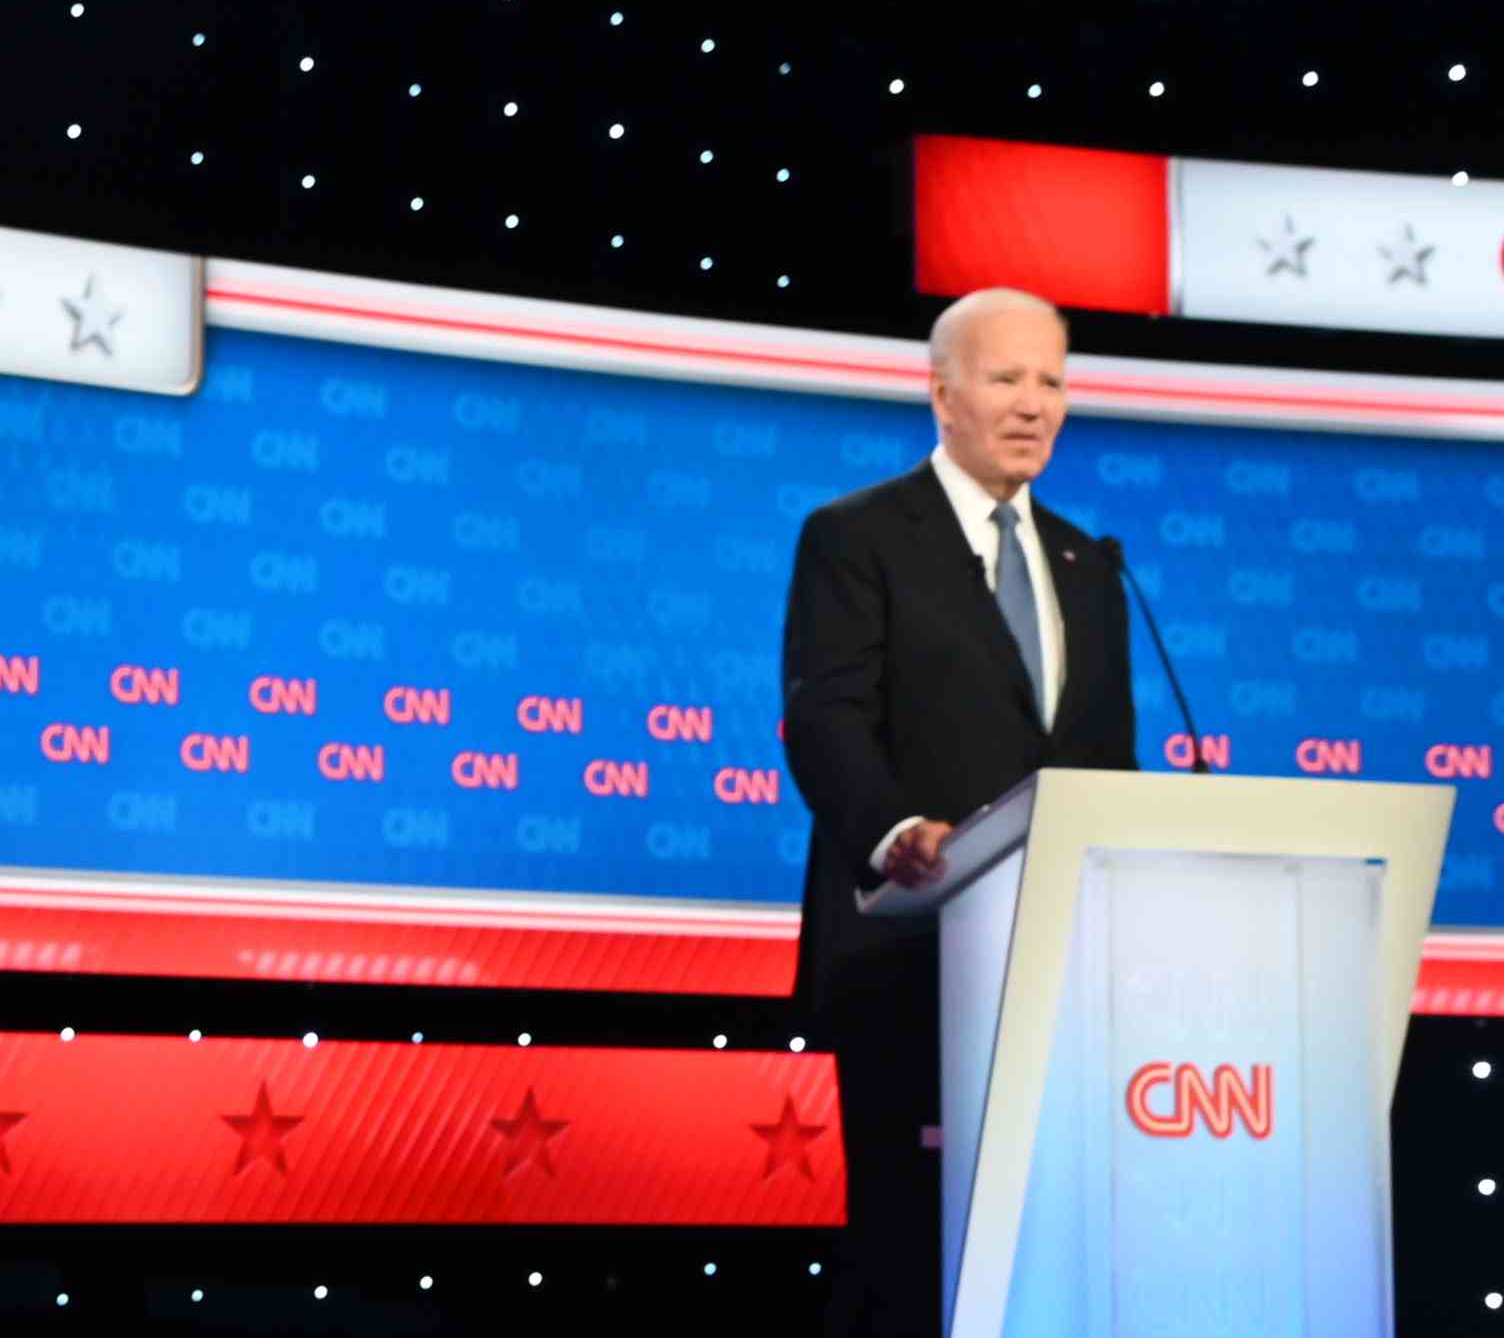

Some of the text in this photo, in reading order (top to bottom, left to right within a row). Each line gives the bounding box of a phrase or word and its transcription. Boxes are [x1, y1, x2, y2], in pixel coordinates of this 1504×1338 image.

[112, 666, 179, 704] CNN
[251, 677, 316, 714] CNN
[385, 688, 449, 724] CNN
[518, 697, 582, 732] CNN
[648, 706, 712, 741] CNN
[42, 724, 109, 763] CNN
[181, 734, 249, 772] CNN
[1296, 739, 1361, 772] CNN
[1426, 745, 1492, 778] CNN
[319, 744, 384, 780] CNN
[453, 752, 518, 789] CNN
[585, 760, 648, 796] CNN
[715, 768, 779, 804] CNN
[1125, 1061, 1273, 1140] CNN
